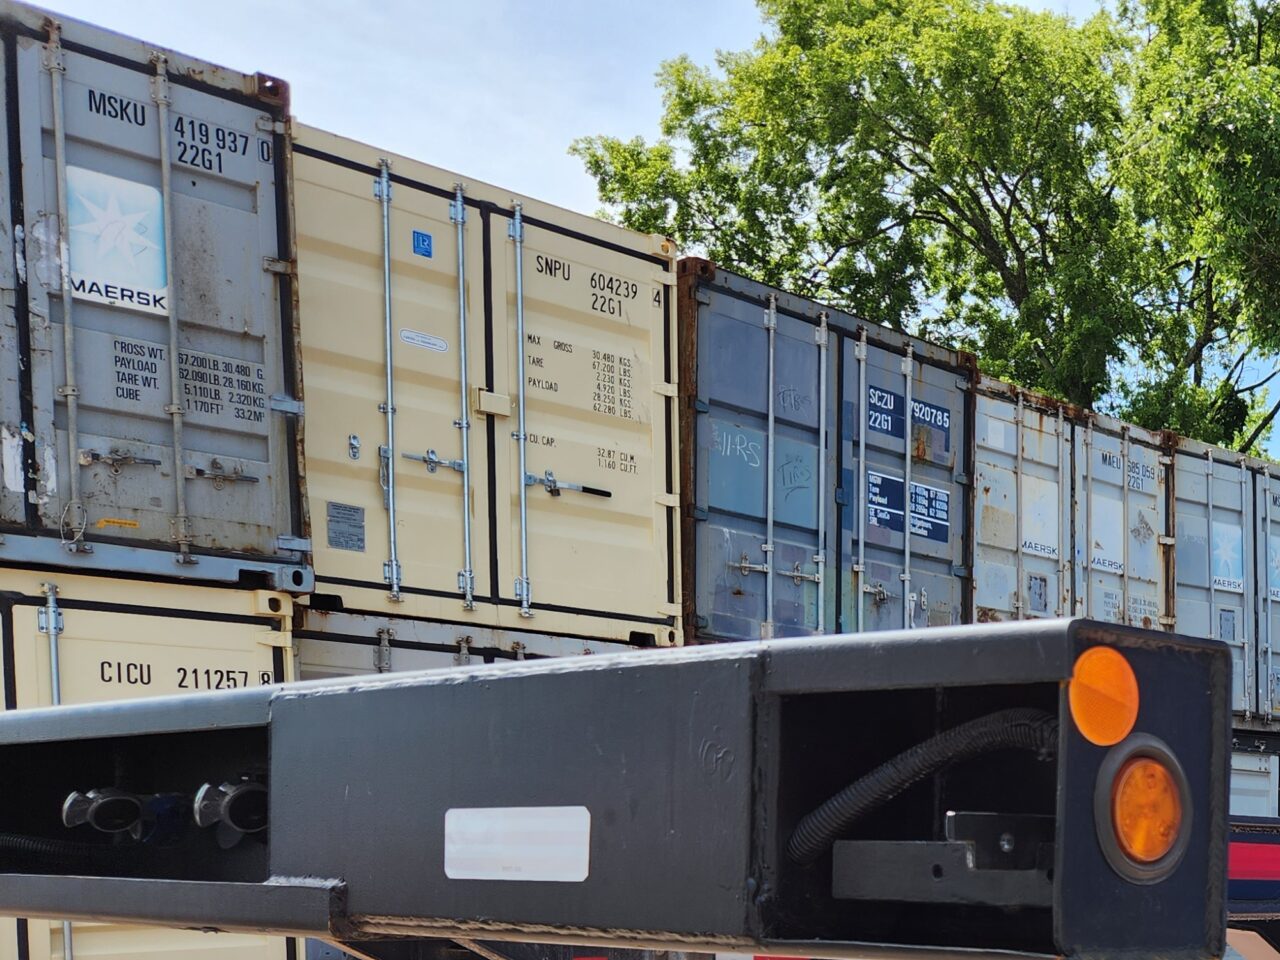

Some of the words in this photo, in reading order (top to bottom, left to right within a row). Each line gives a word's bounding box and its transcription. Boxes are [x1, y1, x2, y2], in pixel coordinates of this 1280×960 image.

[88, 89, 146, 126] MSKU
[174, 116, 209, 145] 419
[216, 128, 249, 156] 937
[260, 139, 271, 162] 0
[178, 142, 223, 173] 22G1
[536, 255, 571, 281] SNPU
[590, 272, 638, 300] 604239
[653, 290, 661, 307] 4
[70, 278, 167, 310] MAERSK
[591, 293, 622, 317] 22G1
[147, 346, 166, 361] WT.
[527, 333, 541, 346] MAX
[553, 340, 573, 353] GROSS
[592, 350, 615, 364] 30.480
[619, 356, 633, 369] KGS.
[114, 355, 157, 374] PAYLOAD
[528, 355, 544, 368] TARE
[596, 371, 615, 385] 2.230
[619, 377, 633, 390] KGS.
[592, 361, 615, 375] 67.200
[619, 367, 633, 380] LBS.
[115, 370, 140, 387] TARE
[141, 376, 160, 390] WT.
[115, 386, 141, 401] CUBE
[528, 376, 559, 393] PAYLOAD
[592, 392, 616, 406] 28.250
[619, 398, 634, 411] KGS.
[596, 382, 615, 395] 4.920
[619, 387, 633, 400] LBS.
[593, 403, 616, 416] 62.280
[620, 408, 634, 420] LBS.
[869, 388, 894, 410] SCZU
[910, 400, 949, 428] 7920785
[869, 410, 892, 432] 22G1
[597, 447, 616, 460] 32.87
[597, 457, 616, 470] 1.160
[1101, 452, 1121, 470] MAEU
[1128, 474, 1144, 491] 22G1
[100, 660, 151, 686] CICU
[176, 667, 248, 690] 211257
